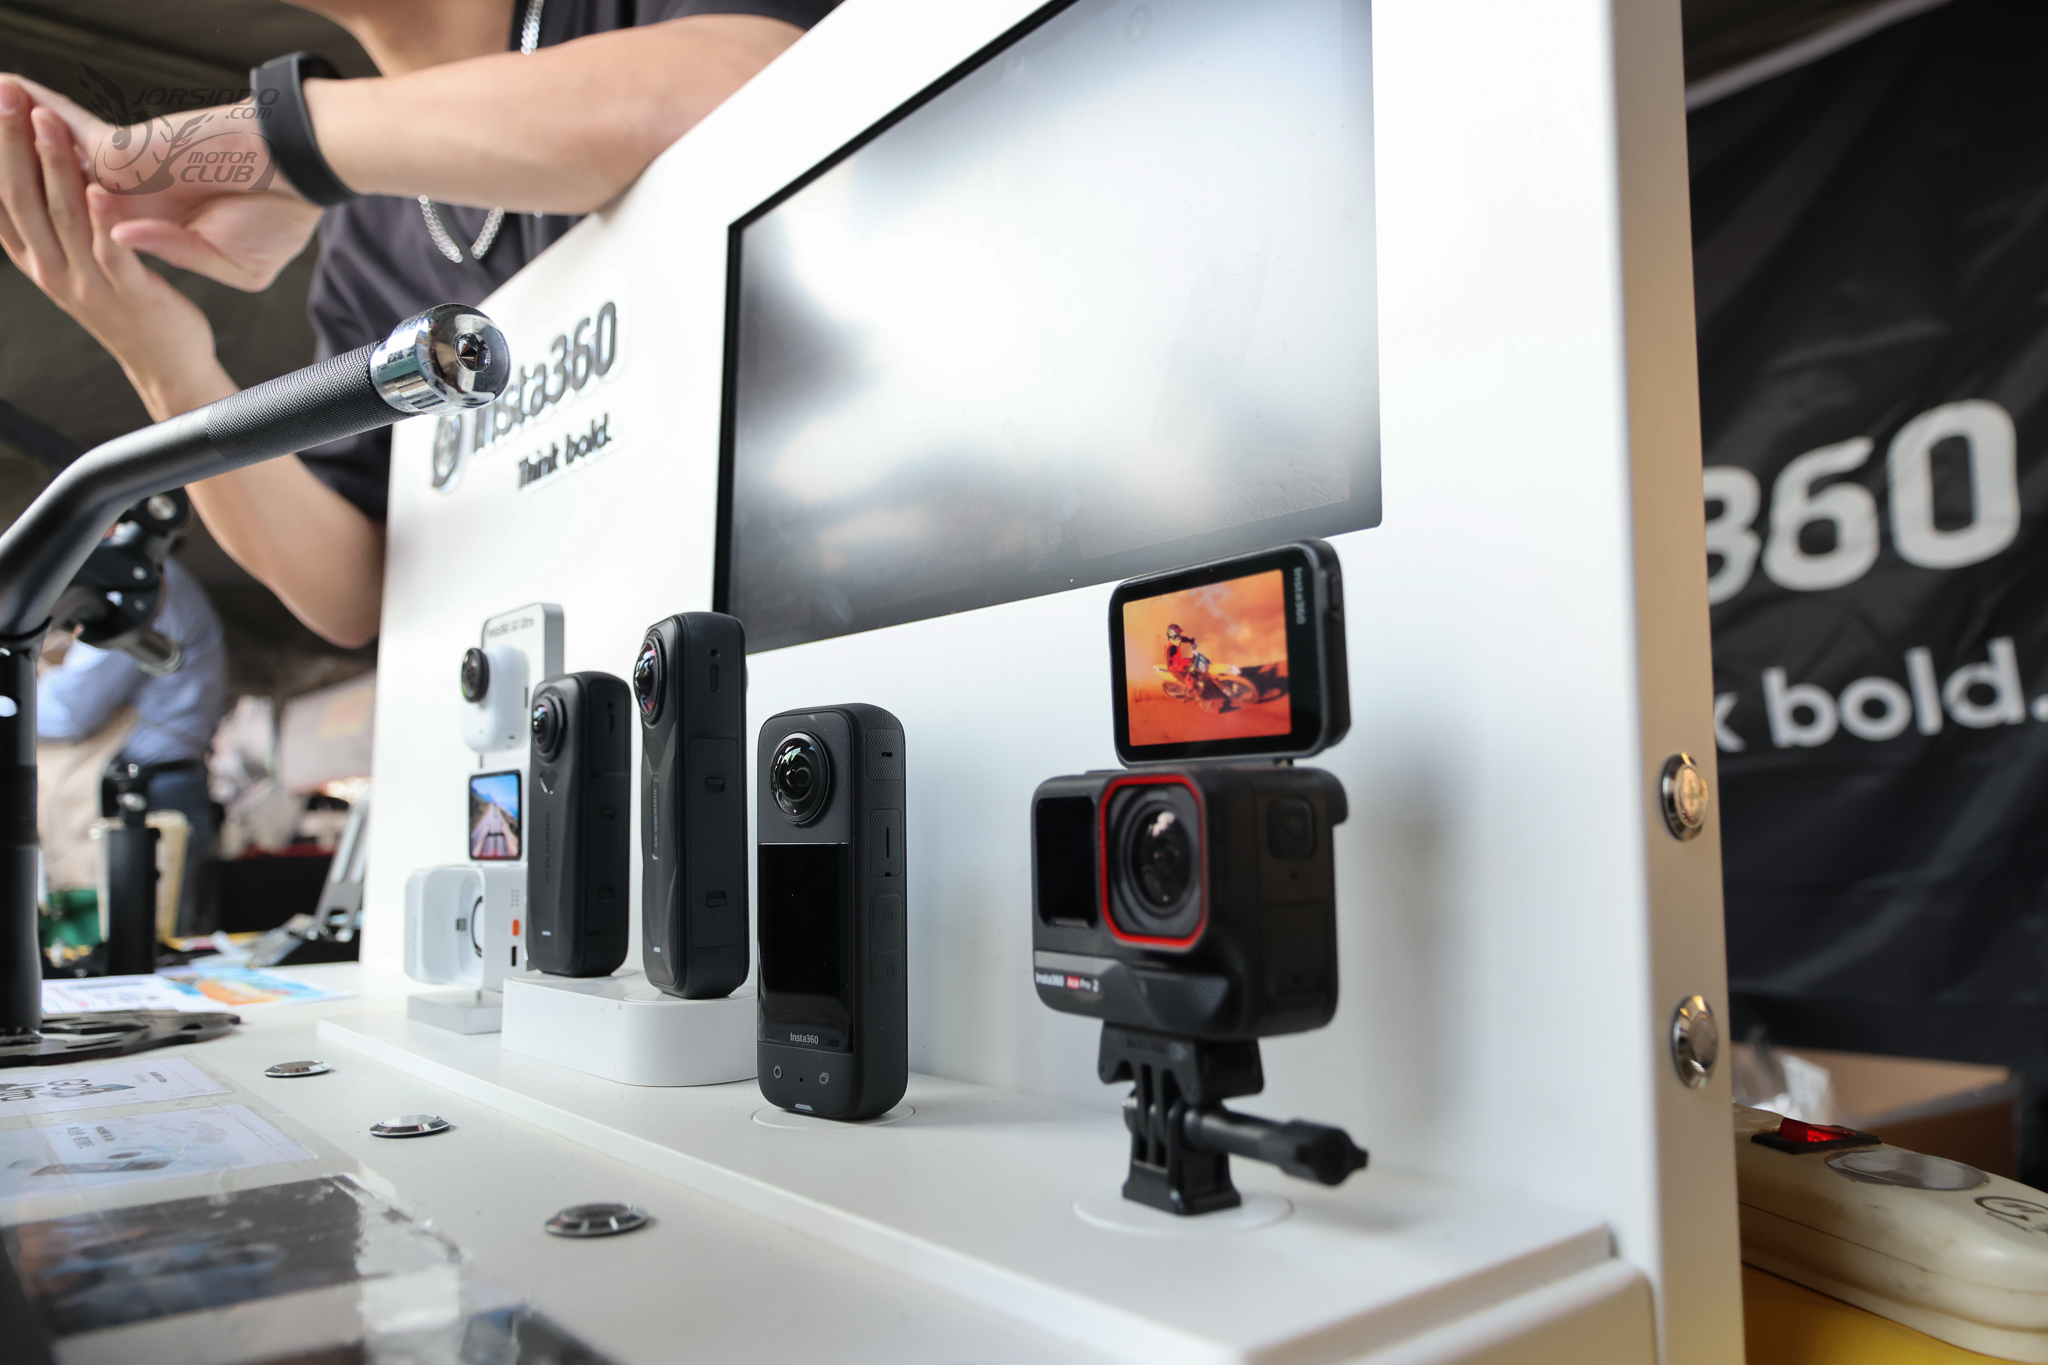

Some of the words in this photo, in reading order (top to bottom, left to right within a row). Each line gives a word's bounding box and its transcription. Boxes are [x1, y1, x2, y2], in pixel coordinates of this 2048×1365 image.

[518, 442, 559, 489] Think
[565, 412, 612, 465] bold.
[790, 1032, 819, 1045] Insta360
